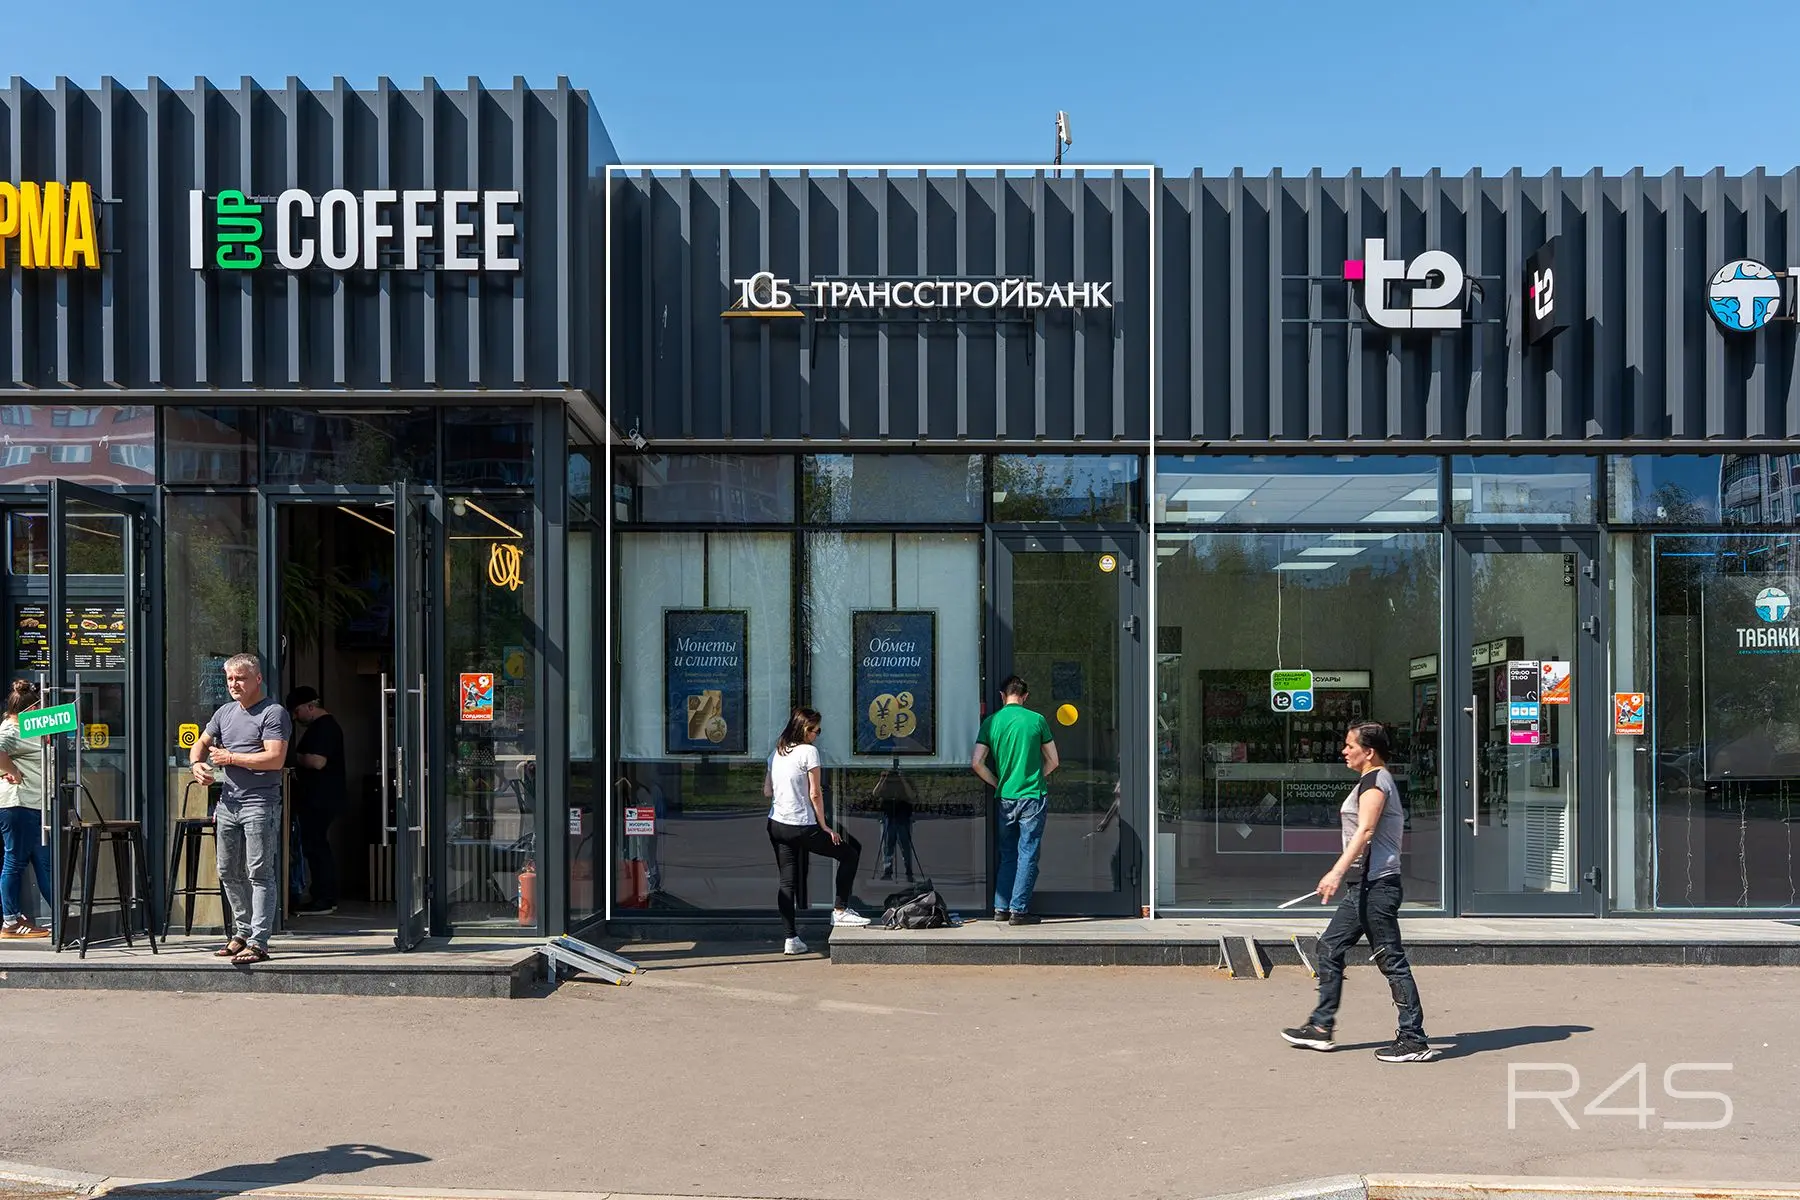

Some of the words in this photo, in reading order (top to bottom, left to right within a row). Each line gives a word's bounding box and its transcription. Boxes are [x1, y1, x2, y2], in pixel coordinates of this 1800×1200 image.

[189, 189, 203, 269] I
[216, 189, 262, 270] CUP
[276, 189, 520, 271] COFFEE
[734, 271, 792, 310] ТСБ
[811, 277, 1113, 308] ТРАНССТРОЙБАНК
[1344, 238, 1462, 329] t2
[1530, 267, 1555, 321] t2
[676, 637, 737, 652] Монеты
[869, 637, 916, 653] Обмен
[1736, 627, 1800, 648] ТАБАКИ
[674, 656, 683, 667] и
[685, 656, 738, 667] слитки
[863, 656, 922, 667] валюты
[1275, 695, 1289, 707] t2
[23, 711, 71, 731] ОТКРЫТО
